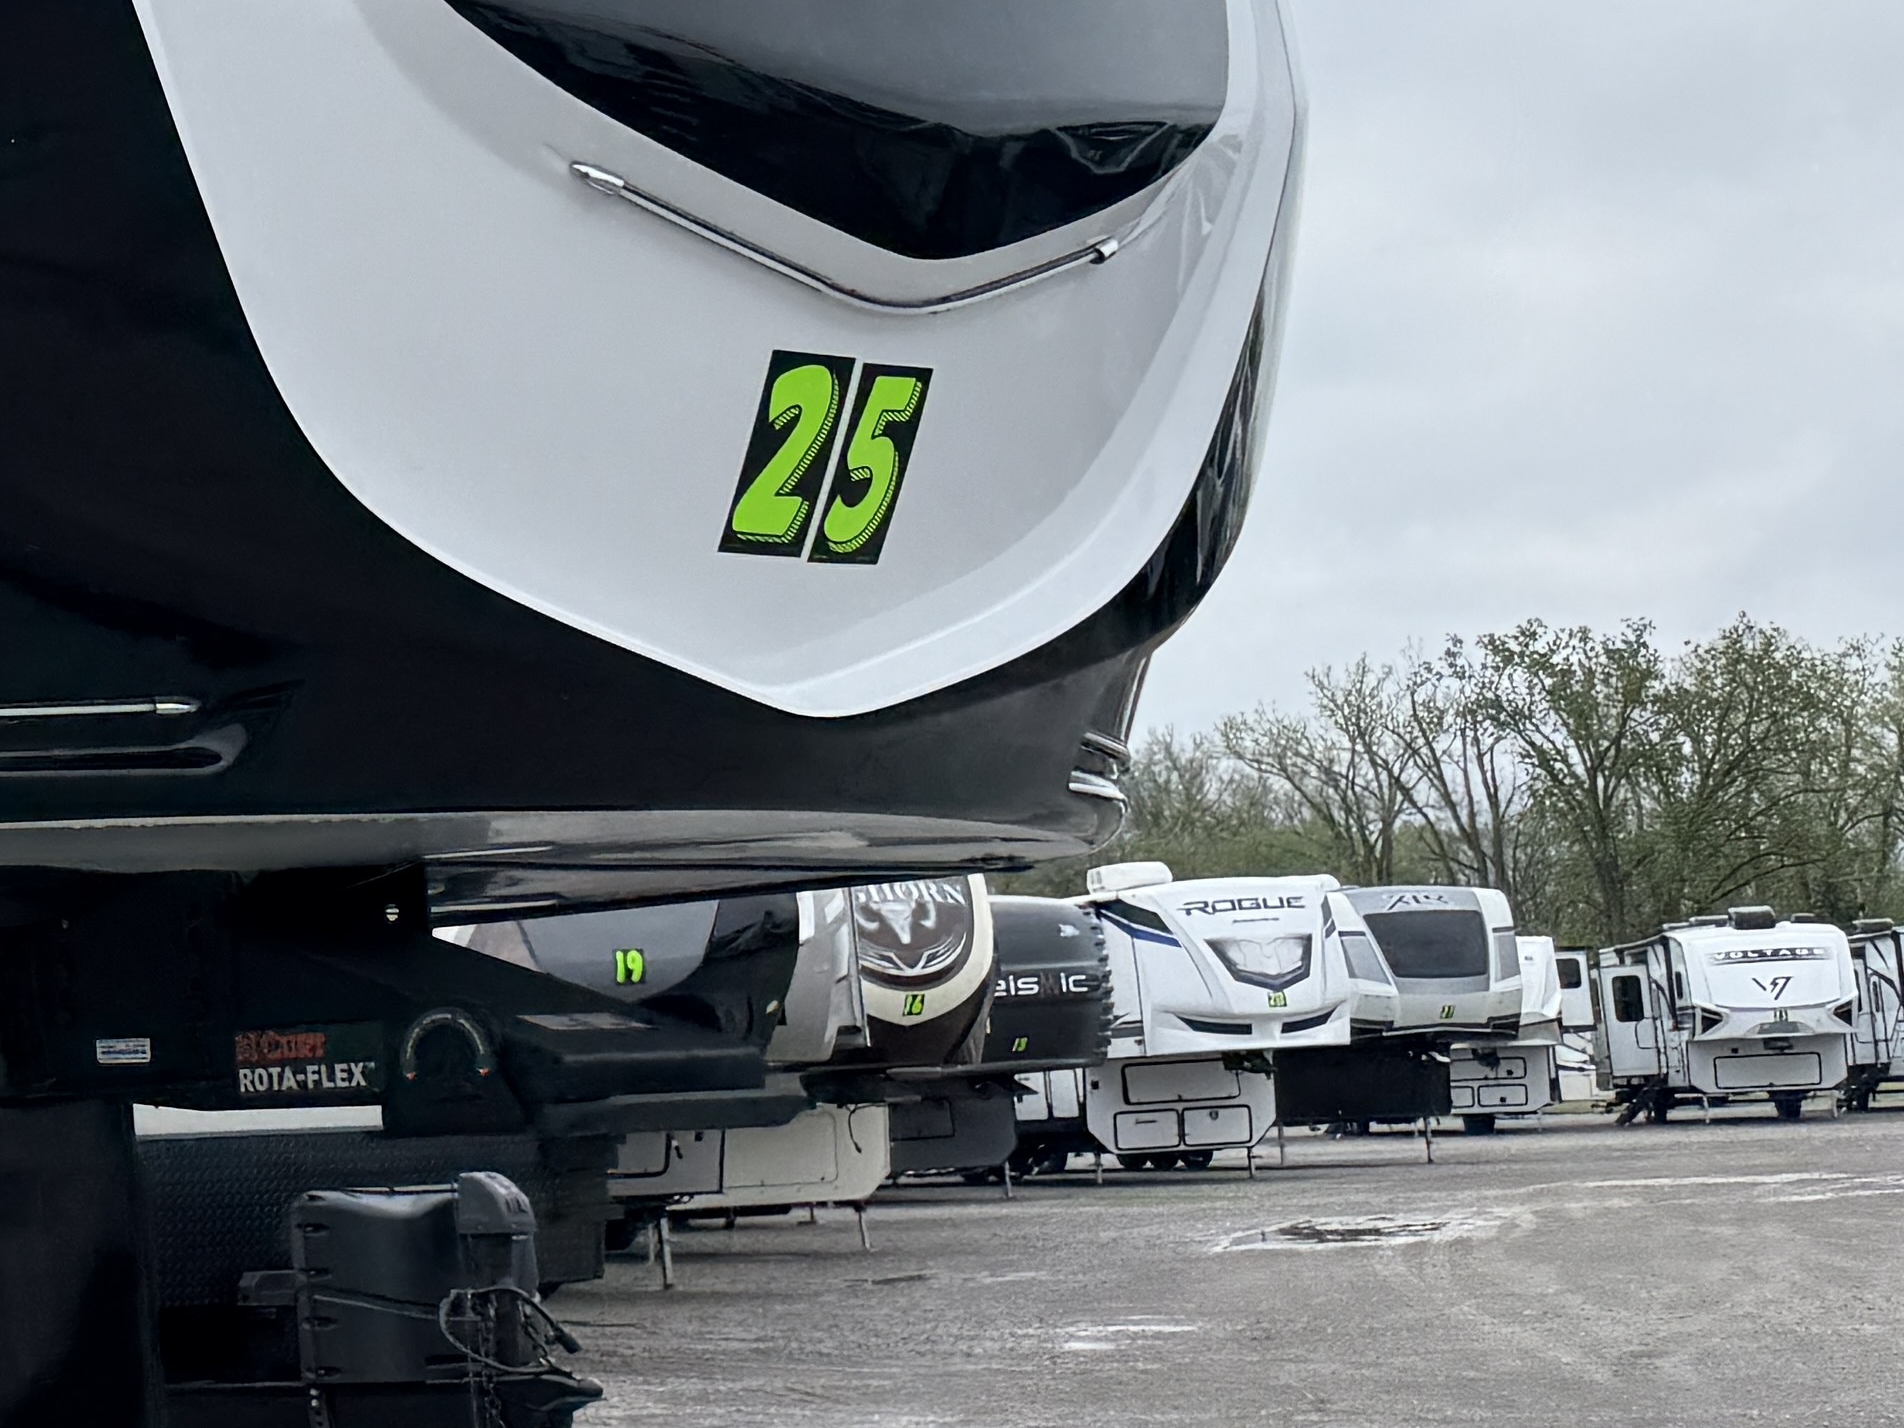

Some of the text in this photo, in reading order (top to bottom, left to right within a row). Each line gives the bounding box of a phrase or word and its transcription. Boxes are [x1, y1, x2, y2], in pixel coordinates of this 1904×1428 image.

[731, 364, 923, 554] 25
[1177, 896, 1306, 916] ROGUE
[615, 949, 643, 983] 19
[239, 1061, 367, 1093] ROTA-FLEX
